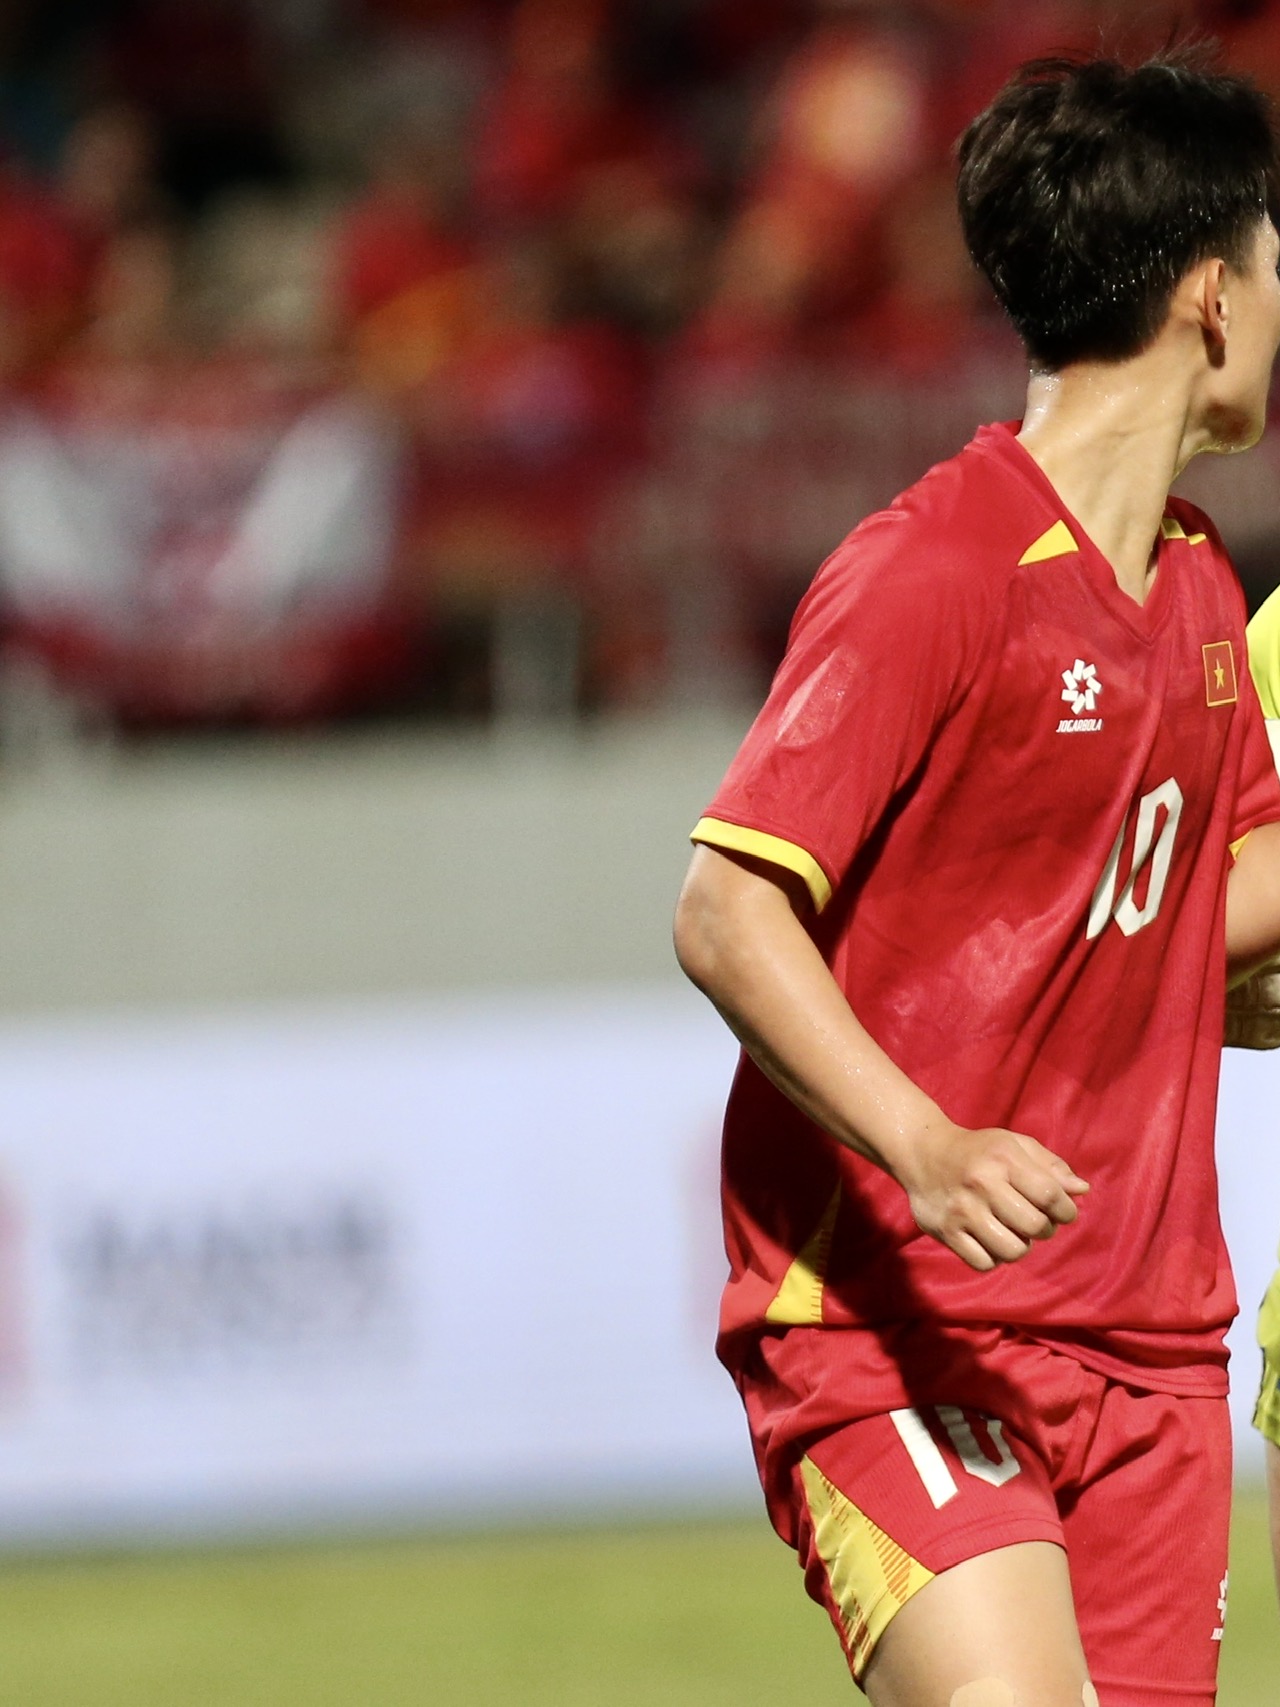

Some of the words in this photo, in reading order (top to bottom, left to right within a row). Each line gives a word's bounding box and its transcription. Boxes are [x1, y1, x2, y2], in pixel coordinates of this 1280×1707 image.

[1056, 718, 1103, 733] JOGARBOLA
[1085, 777, 1184, 940] 10
[889, 1404, 1020, 1510] 10
